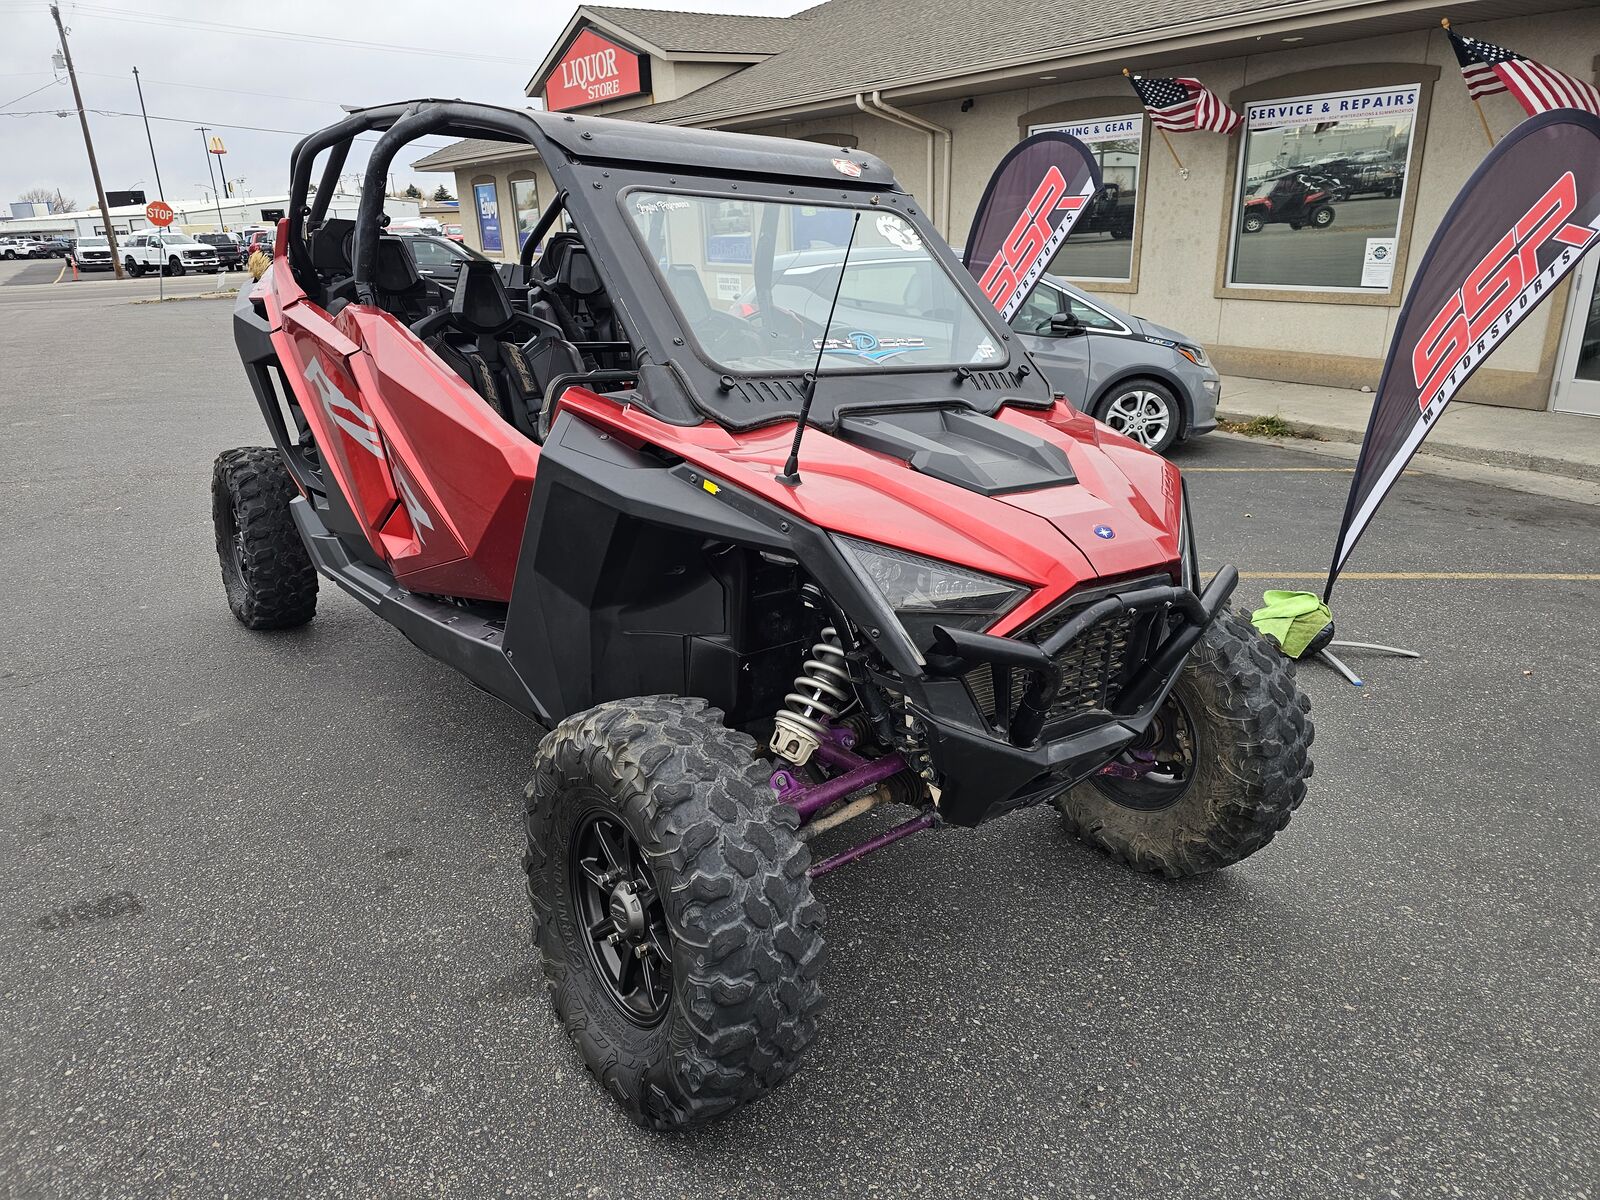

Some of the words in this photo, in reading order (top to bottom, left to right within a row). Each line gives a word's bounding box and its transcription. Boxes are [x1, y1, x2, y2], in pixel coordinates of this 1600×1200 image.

[561, 48, 619, 90] LIQUOR
[587, 79, 620, 100] STORE
[1250, 104, 1313, 120] SERVICE
[1321, 102, 1330, 113] &
[1340, 93, 1415, 111] REPAIRS
[1094, 125, 1100, 134] &
[1105, 121, 1133, 133] GEAR
[147, 207, 173, 220] STOP
[1002, 213, 1073, 320] OTORSPORTS
[1412, 171, 1598, 412] SSR
[1422, 250, 1571, 425] MOTORSPORTS
